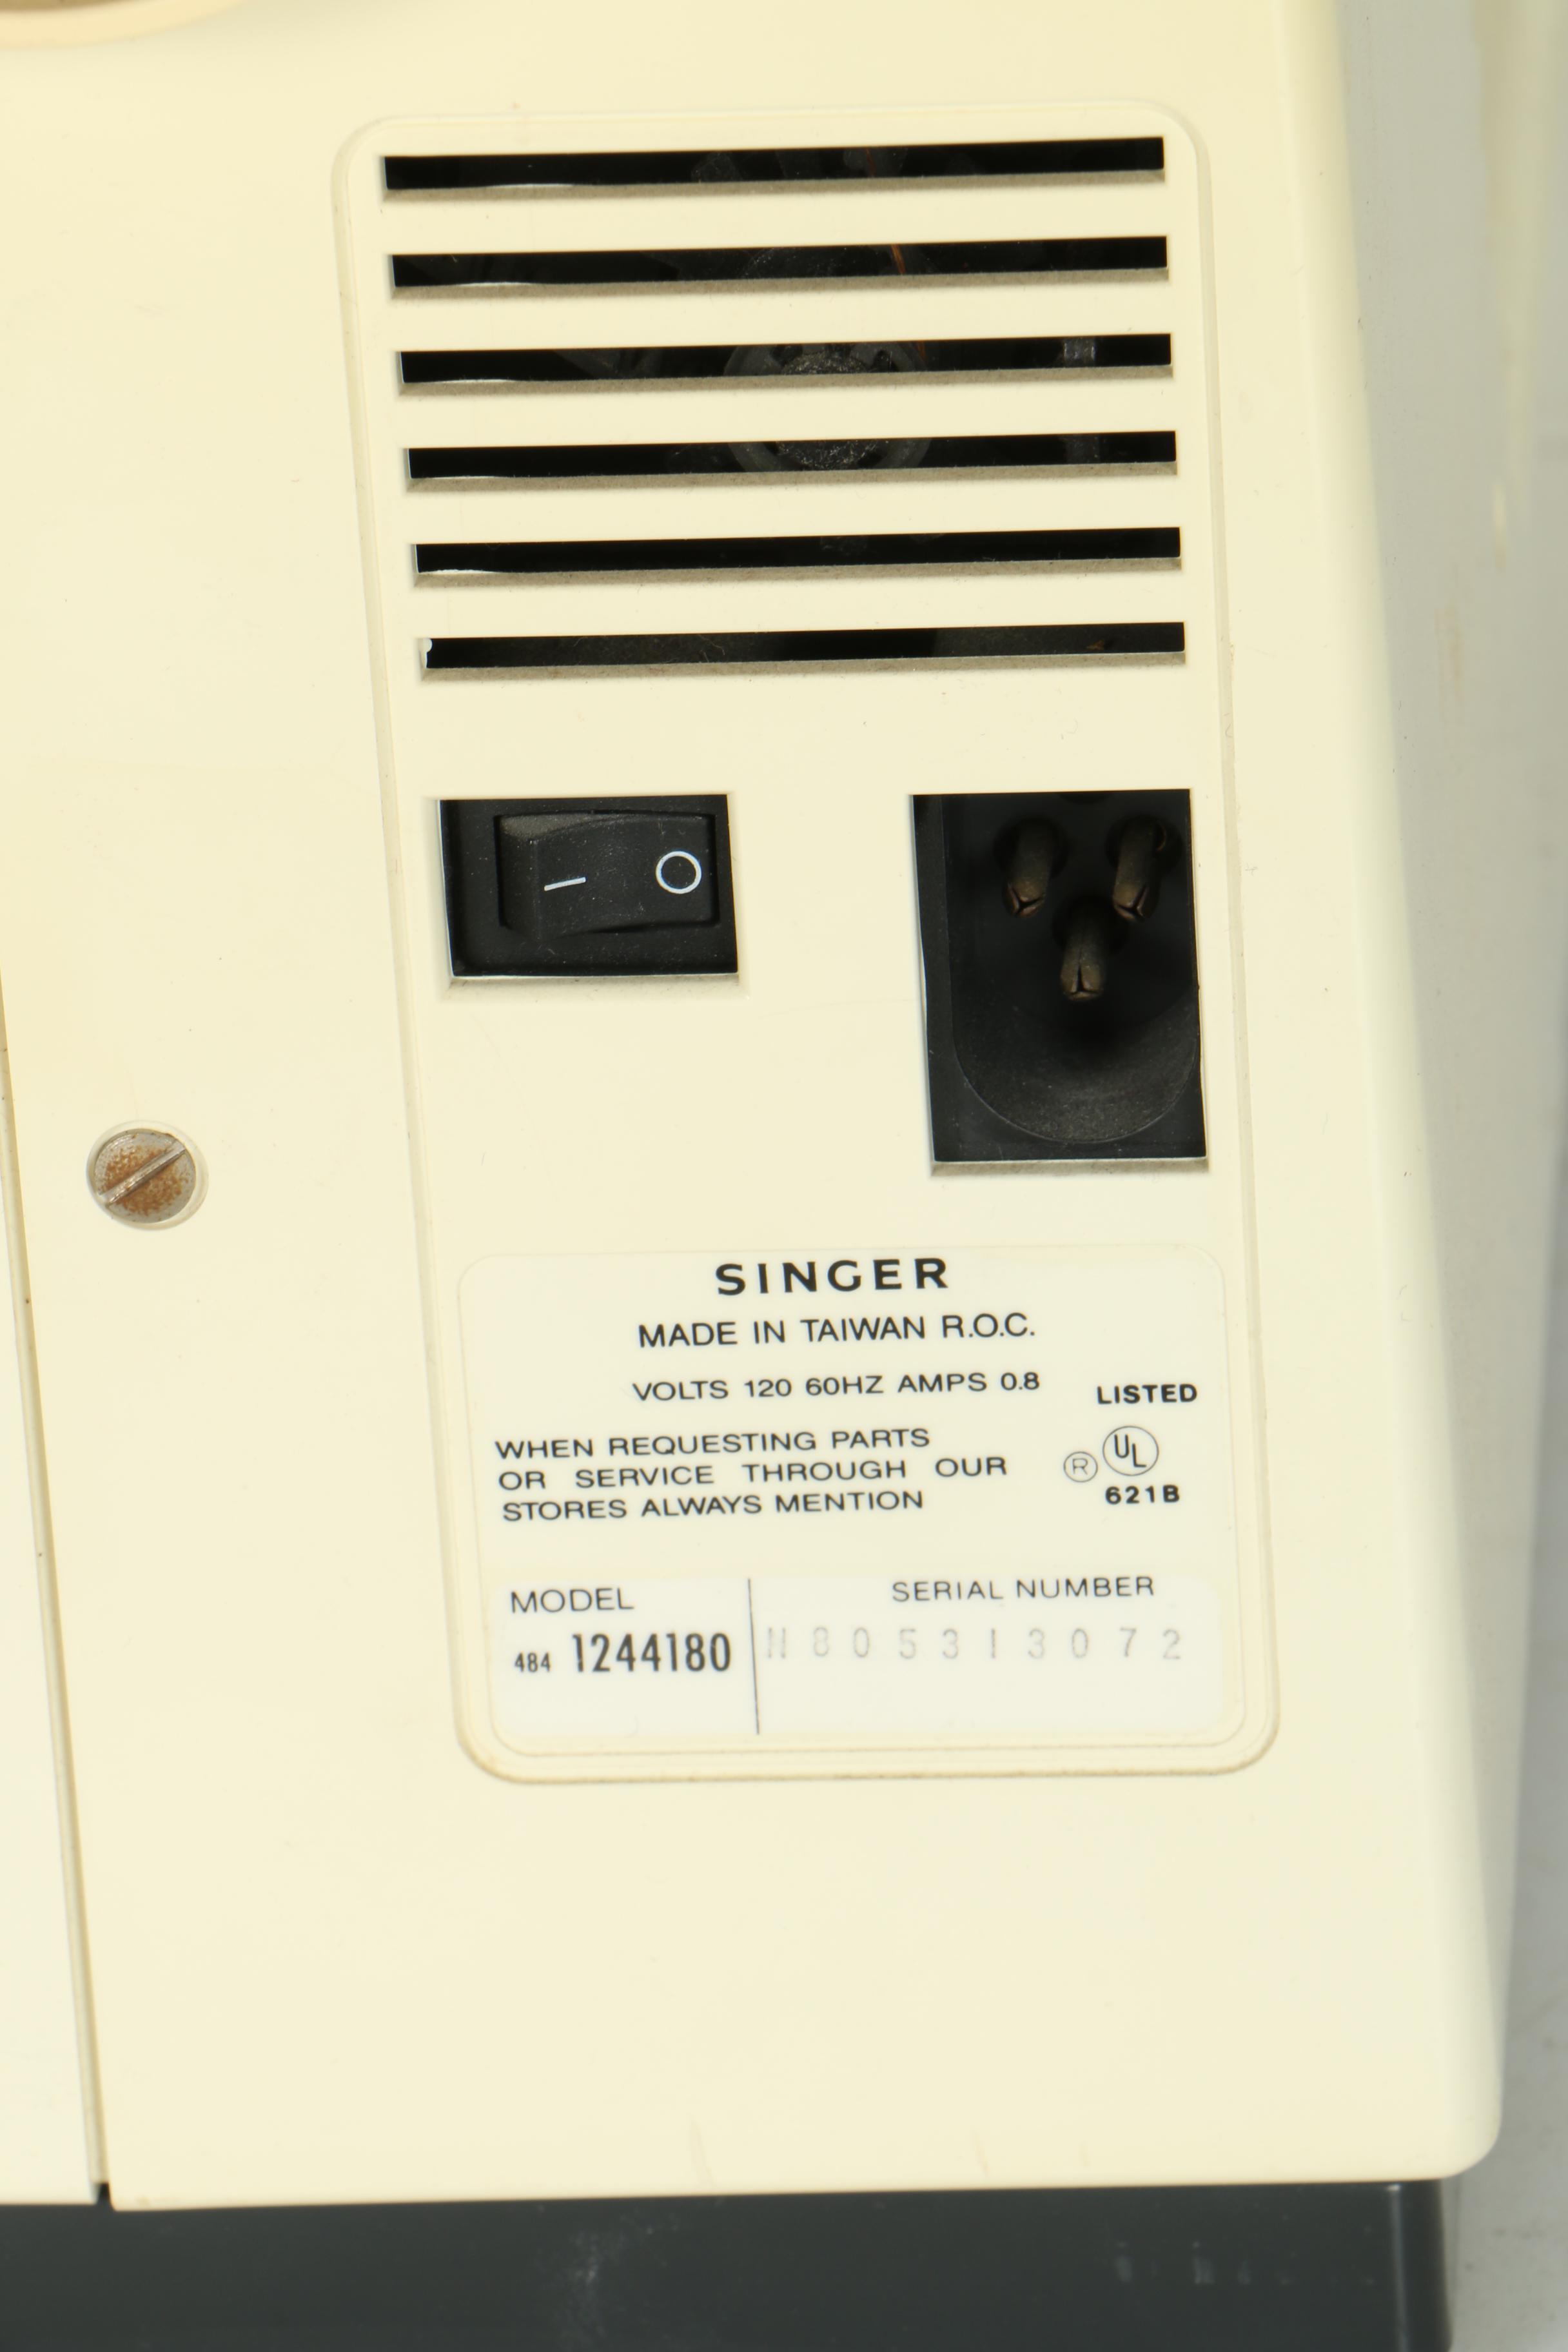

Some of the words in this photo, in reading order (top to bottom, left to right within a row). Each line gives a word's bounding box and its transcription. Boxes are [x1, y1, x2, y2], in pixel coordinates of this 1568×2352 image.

[715, 1257, 948, 1296] SINGER
[638, 1321, 738, 1348] MADE
[753, 1320, 785, 1344] IN
[799, 1316, 925, 1342] TAIWAN
[941, 1312, 1035, 1338] R.O.C.
[632, 1380, 729, 1401] VOLTS
[744, 1378, 792, 1398] 120
[805, 1375, 884, 1396] 60HZ
[897, 1372, 987, 1393] AMPS
[1000, 1371, 1040, 1391] 0.8
[1097, 1383, 1198, 1405] LISTED
[495, 1438, 593, 1460] WHEN
[609, 1431, 816, 1456] REQUESTING
[832, 1427, 930, 1449] PARTS
[498, 1471, 546, 1491] OR
[575, 1465, 714, 1489] SERVICE
[741, 1460, 906, 1482] THROUGH
[935, 1456, 1007, 1478] OUR
[503, 1499, 627, 1522] STORES
[641, 1494, 762, 1517] ALWAYS
[775, 1491, 923, 1513] MENTION
[1104, 1484, 1181, 1505] 621B
[511, 1587, 634, 1613] MODEL
[892, 1580, 1003, 1602] SERIAL
[1016, 1576, 1154, 1598] NUMBER
[514, 1652, 551, 1673] 484
[572, 1632, 731, 1673] 1244180
